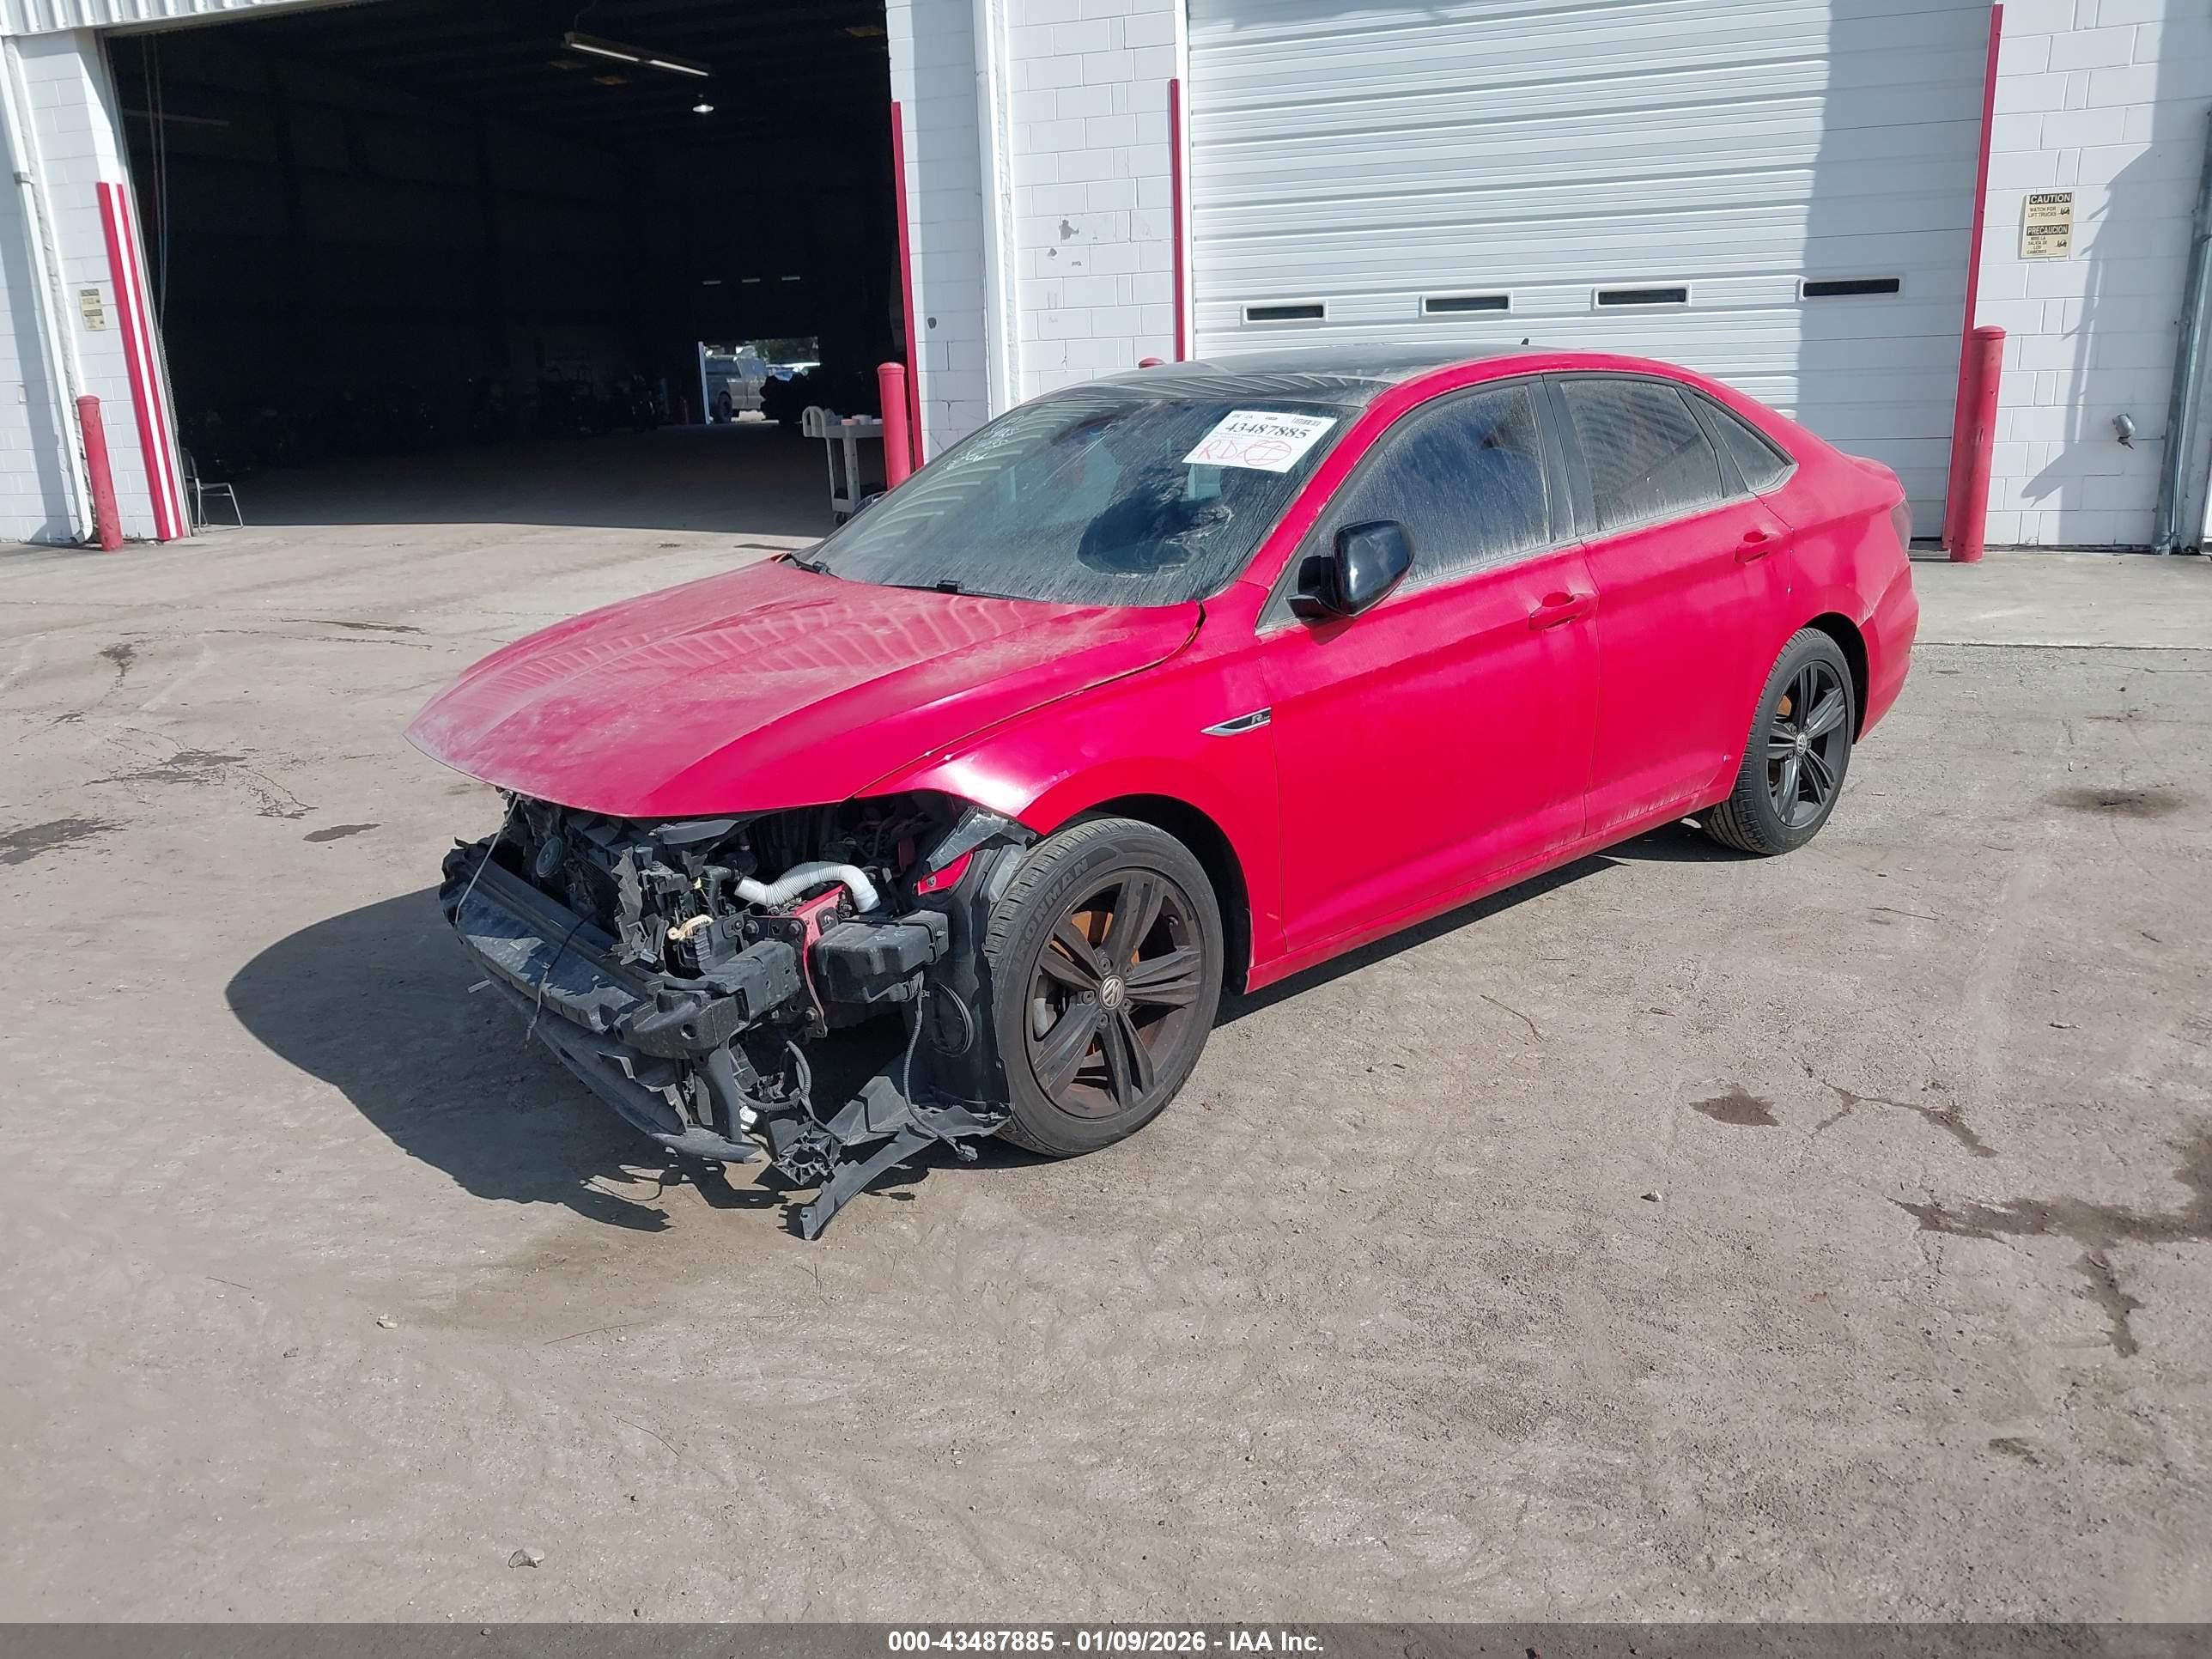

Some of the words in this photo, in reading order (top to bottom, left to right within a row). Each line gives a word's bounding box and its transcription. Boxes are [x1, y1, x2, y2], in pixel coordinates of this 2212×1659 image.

[2031, 194, 2070, 204] CAUTION
[2027, 225, 2068, 235] PRECAUCION
[1225, 422, 1312, 439] 43487885
